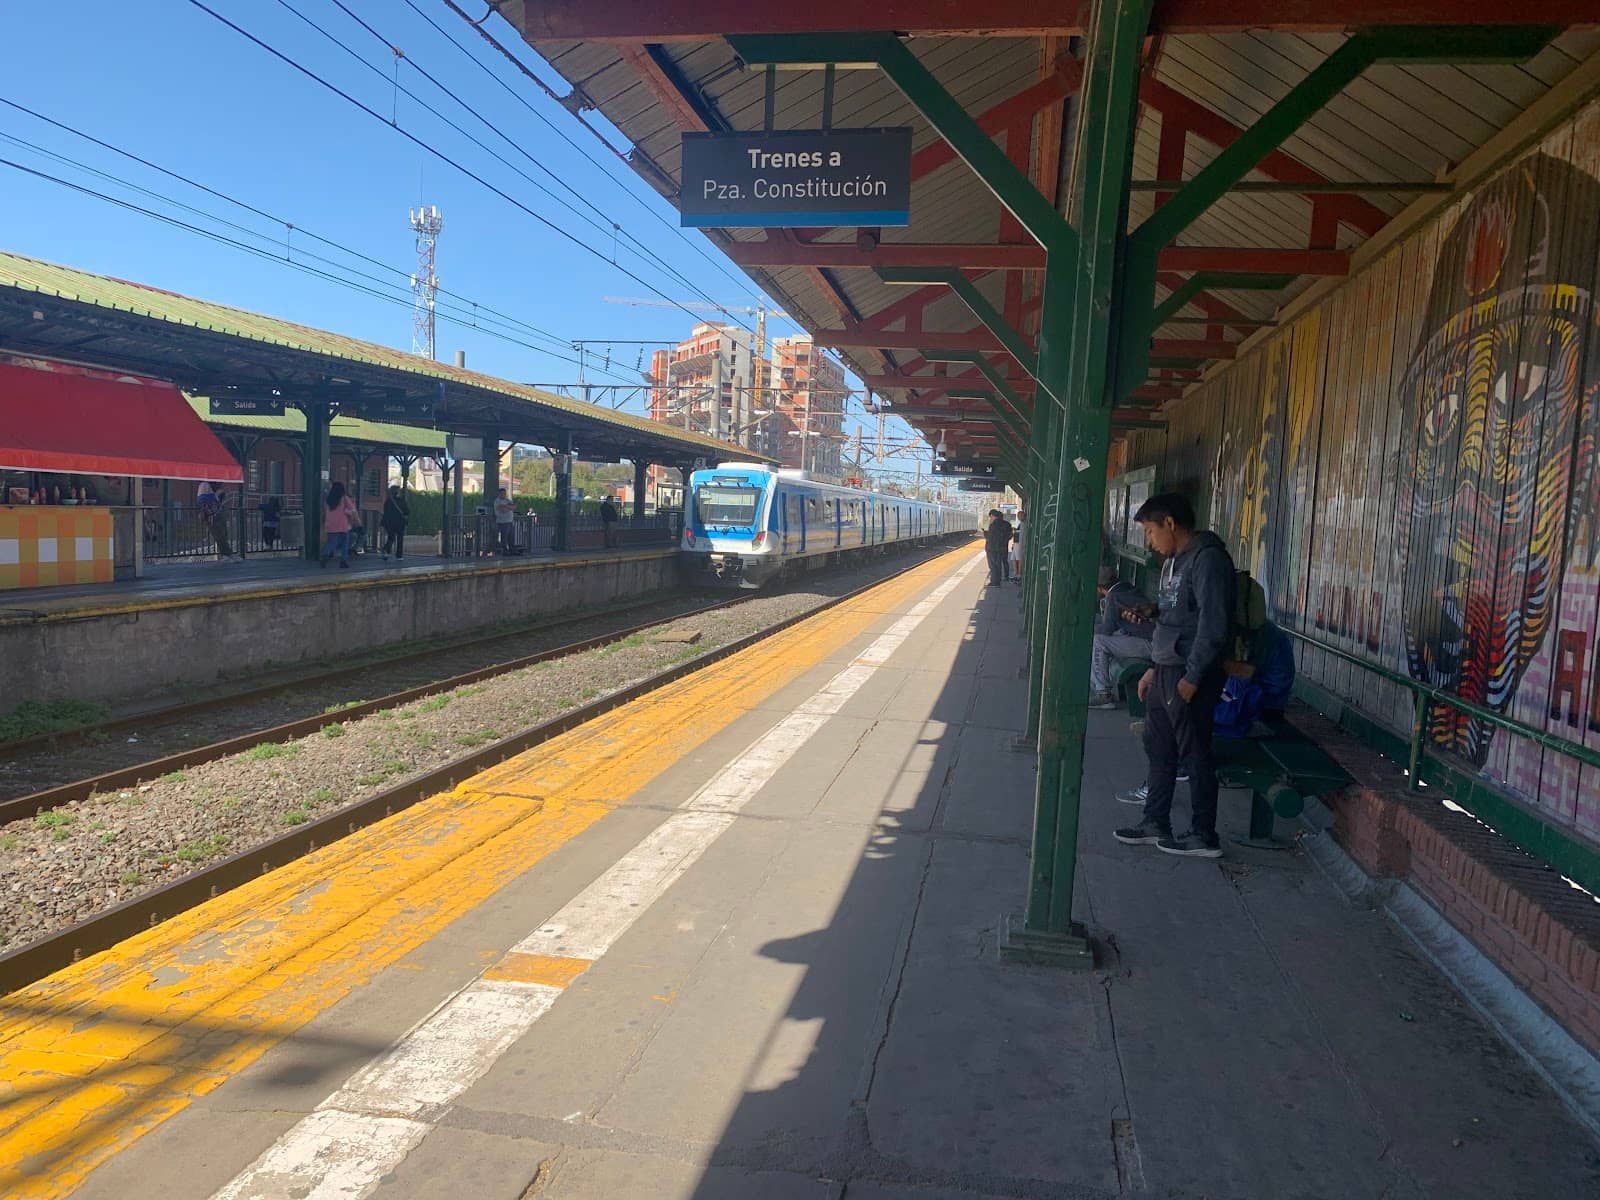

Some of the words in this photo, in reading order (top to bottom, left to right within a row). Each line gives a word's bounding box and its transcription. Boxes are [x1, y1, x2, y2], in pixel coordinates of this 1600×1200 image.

[748, 149, 823, 169] Trenes
[828, 151, 841, 167] a
[703, 179, 746, 199] Pza.
[753, 174, 887, 199] Constitución
[234, 400, 257, 409] Salida
[954, 465, 973, 473] Salida
